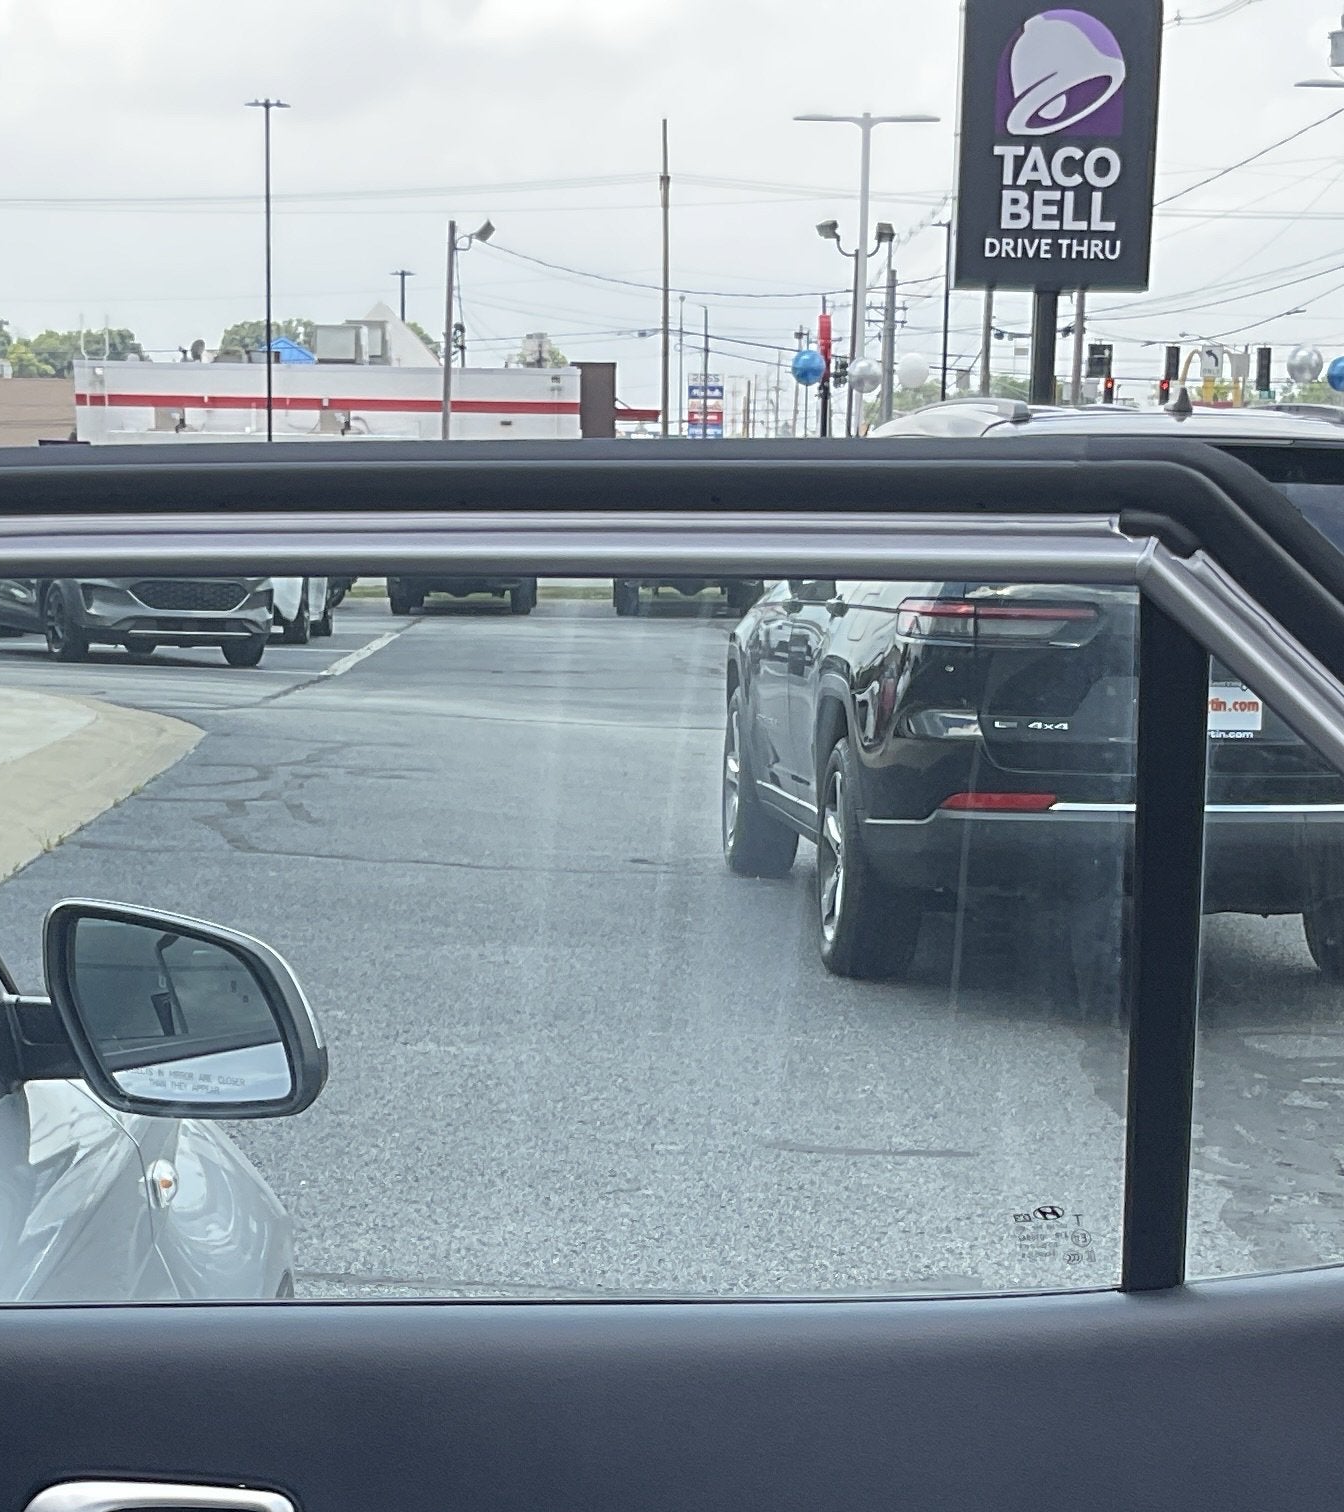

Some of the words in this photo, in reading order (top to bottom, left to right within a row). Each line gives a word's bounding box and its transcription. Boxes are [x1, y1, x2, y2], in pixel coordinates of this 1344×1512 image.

[993, 145, 1121, 188] TACO
[1000, 189, 1116, 231] BELL
[984, 238, 1052, 259] DRIVE
[1057, 239, 1121, 260] THRU
[1028, 721, 1068, 730] 4x4
